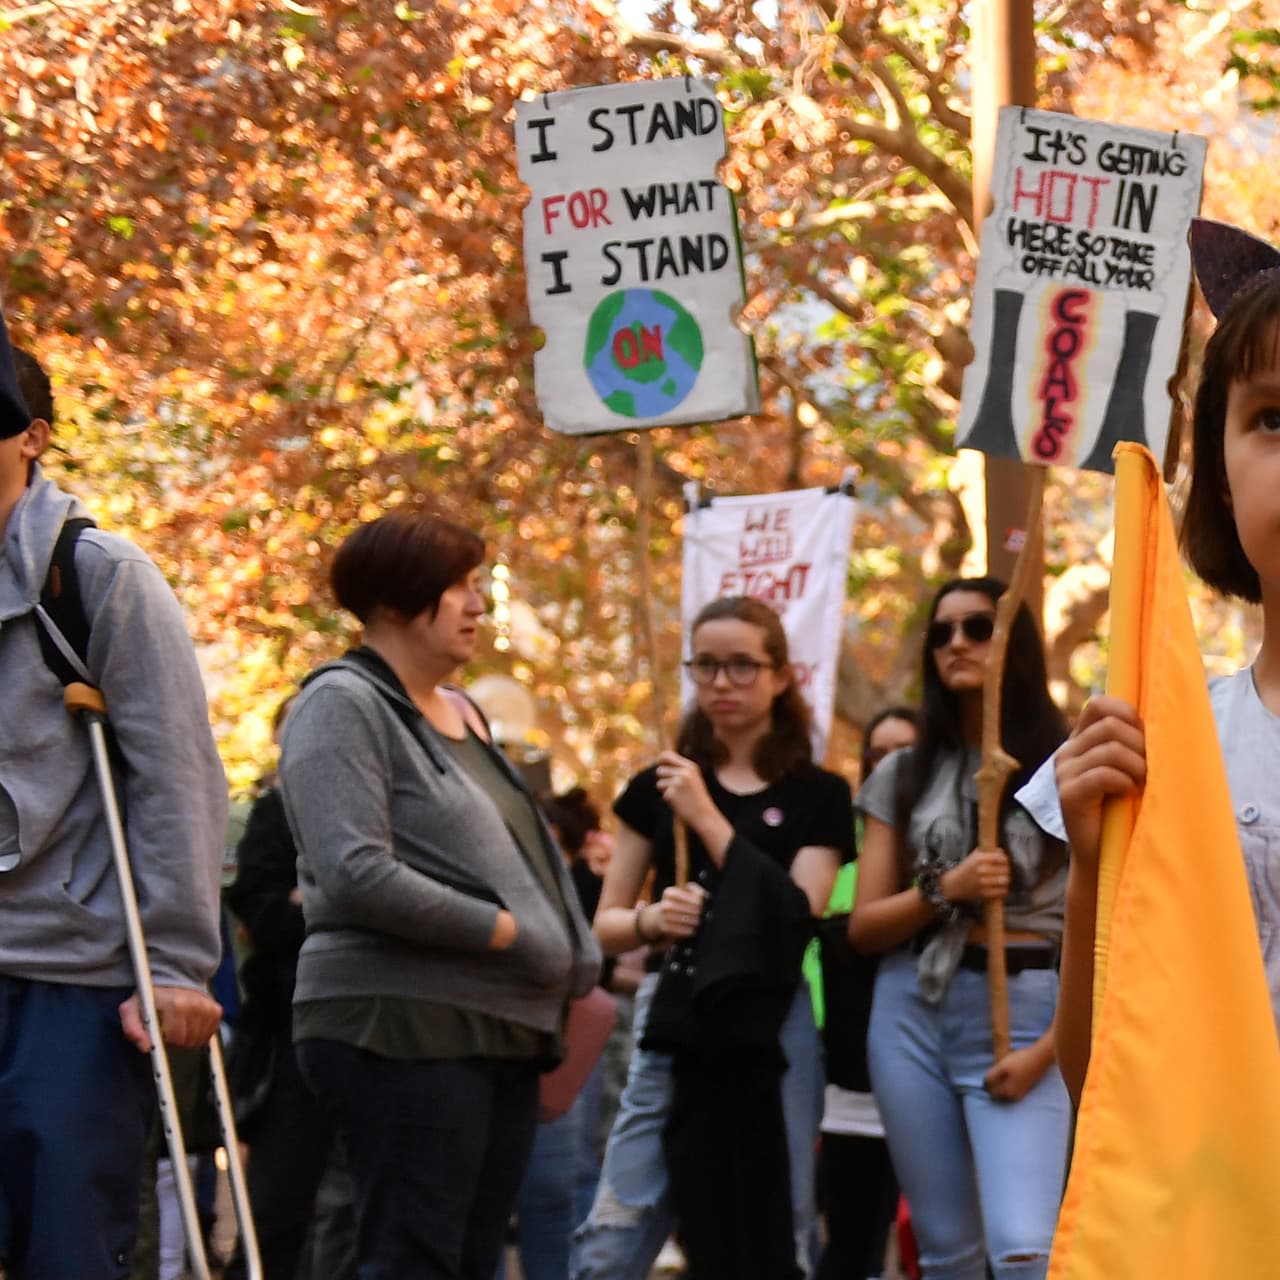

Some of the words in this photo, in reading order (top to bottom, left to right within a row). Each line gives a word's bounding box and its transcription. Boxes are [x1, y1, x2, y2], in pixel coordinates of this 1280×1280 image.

[527, 117, 557, 164] I
[588, 97, 719, 153] STAND
[1097, 140, 1188, 178] GETTING
[543, 188, 613, 235] FOR
[621, 180, 719, 221] WHAT
[1013, 166, 1112, 231] HOT
[1113, 178, 1159, 234] IN
[541, 251, 572, 296] I
[601, 233, 729, 287] STAND
[1021, 253, 1063, 278] OFF
[1063, 255, 1102, 285] ALL
[1102, 258, 1156, 292] YOUR
[1109, 235, 1156, 267] TAKE
[612, 325, 664, 370] ON
[1034, 290, 1091, 459] COALS
[744, 508, 791, 532] WE
